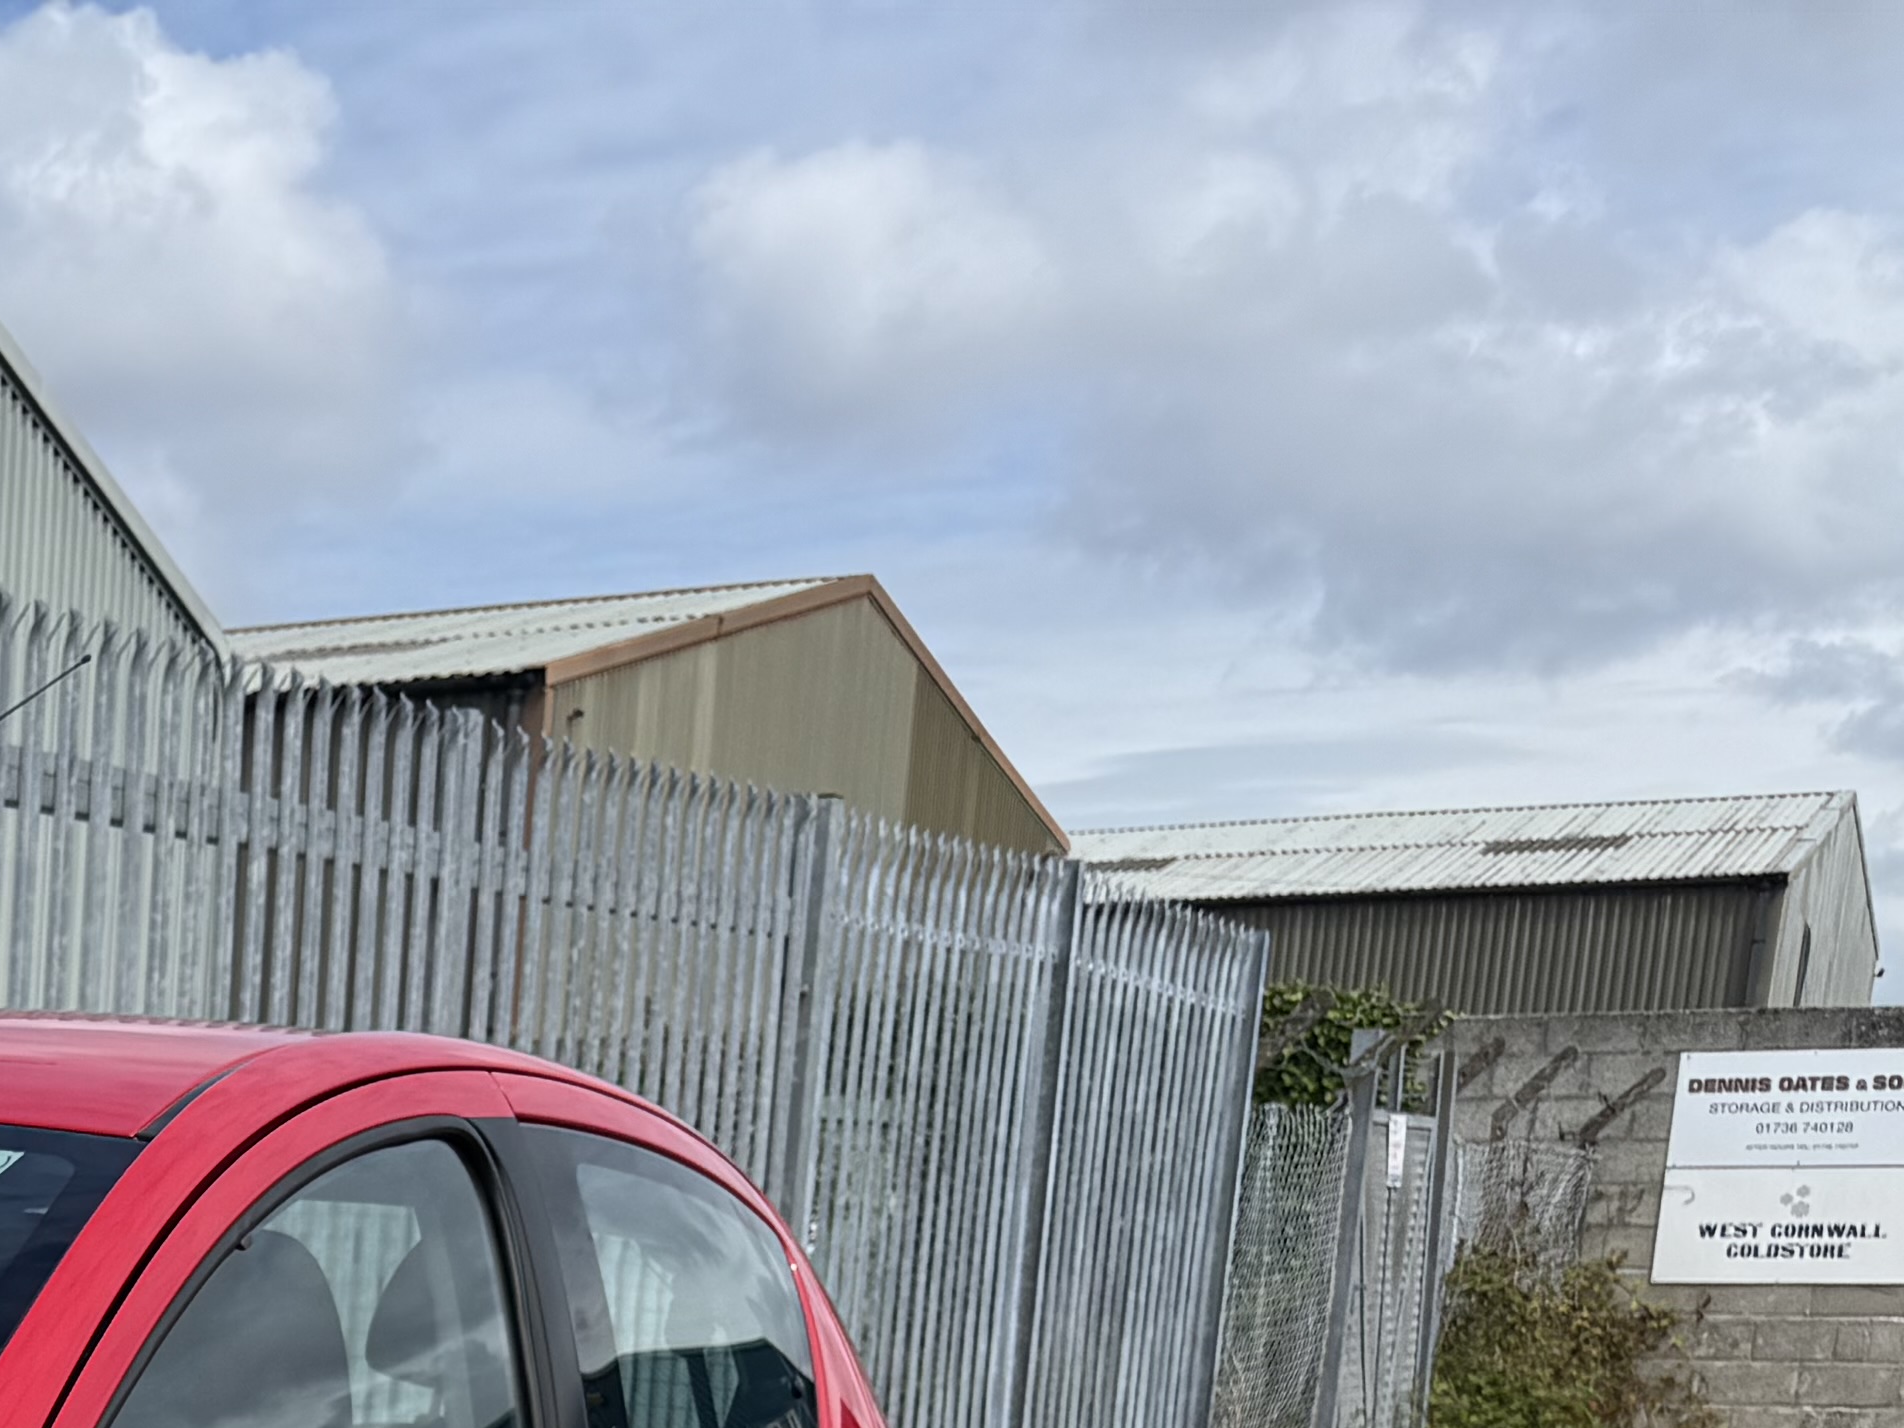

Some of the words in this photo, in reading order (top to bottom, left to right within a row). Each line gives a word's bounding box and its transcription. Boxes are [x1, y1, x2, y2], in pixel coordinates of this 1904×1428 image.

[1688, 1076, 1772, 1094] DENNIS
[1778, 1074, 1850, 1093] OATES
[1872, 1074, 1904, 1091] SO
[1709, 1100, 1781, 1115] STORAGE
[1698, 1222, 1763, 1239] WEST
[1770, 1222, 1888, 1239] CORNWALL
[1726, 1242, 1852, 1259] COLDSTORE
